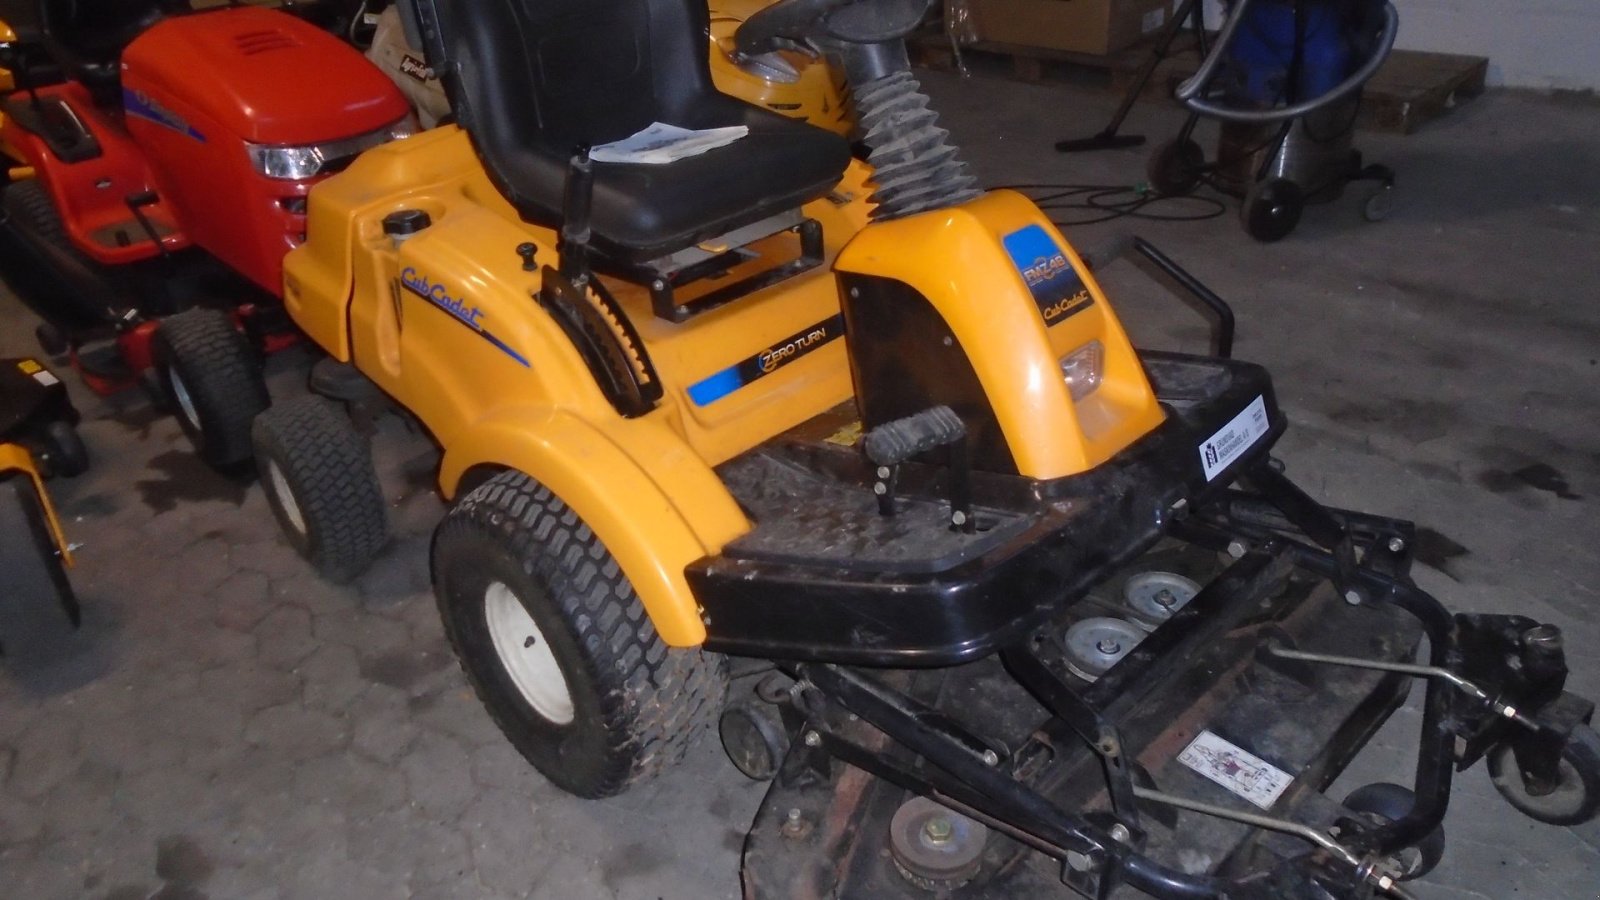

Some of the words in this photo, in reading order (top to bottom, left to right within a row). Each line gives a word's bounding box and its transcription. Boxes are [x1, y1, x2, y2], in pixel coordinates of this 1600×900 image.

[401, 267, 429, 296] Cub
[429, 284, 484, 328] Cadet
[1044, 304, 1061, 320] Cub
[1061, 290, 1088, 311] Cadet
[762, 344, 795, 368] ZERO
[795, 327, 826, 349] TURN
